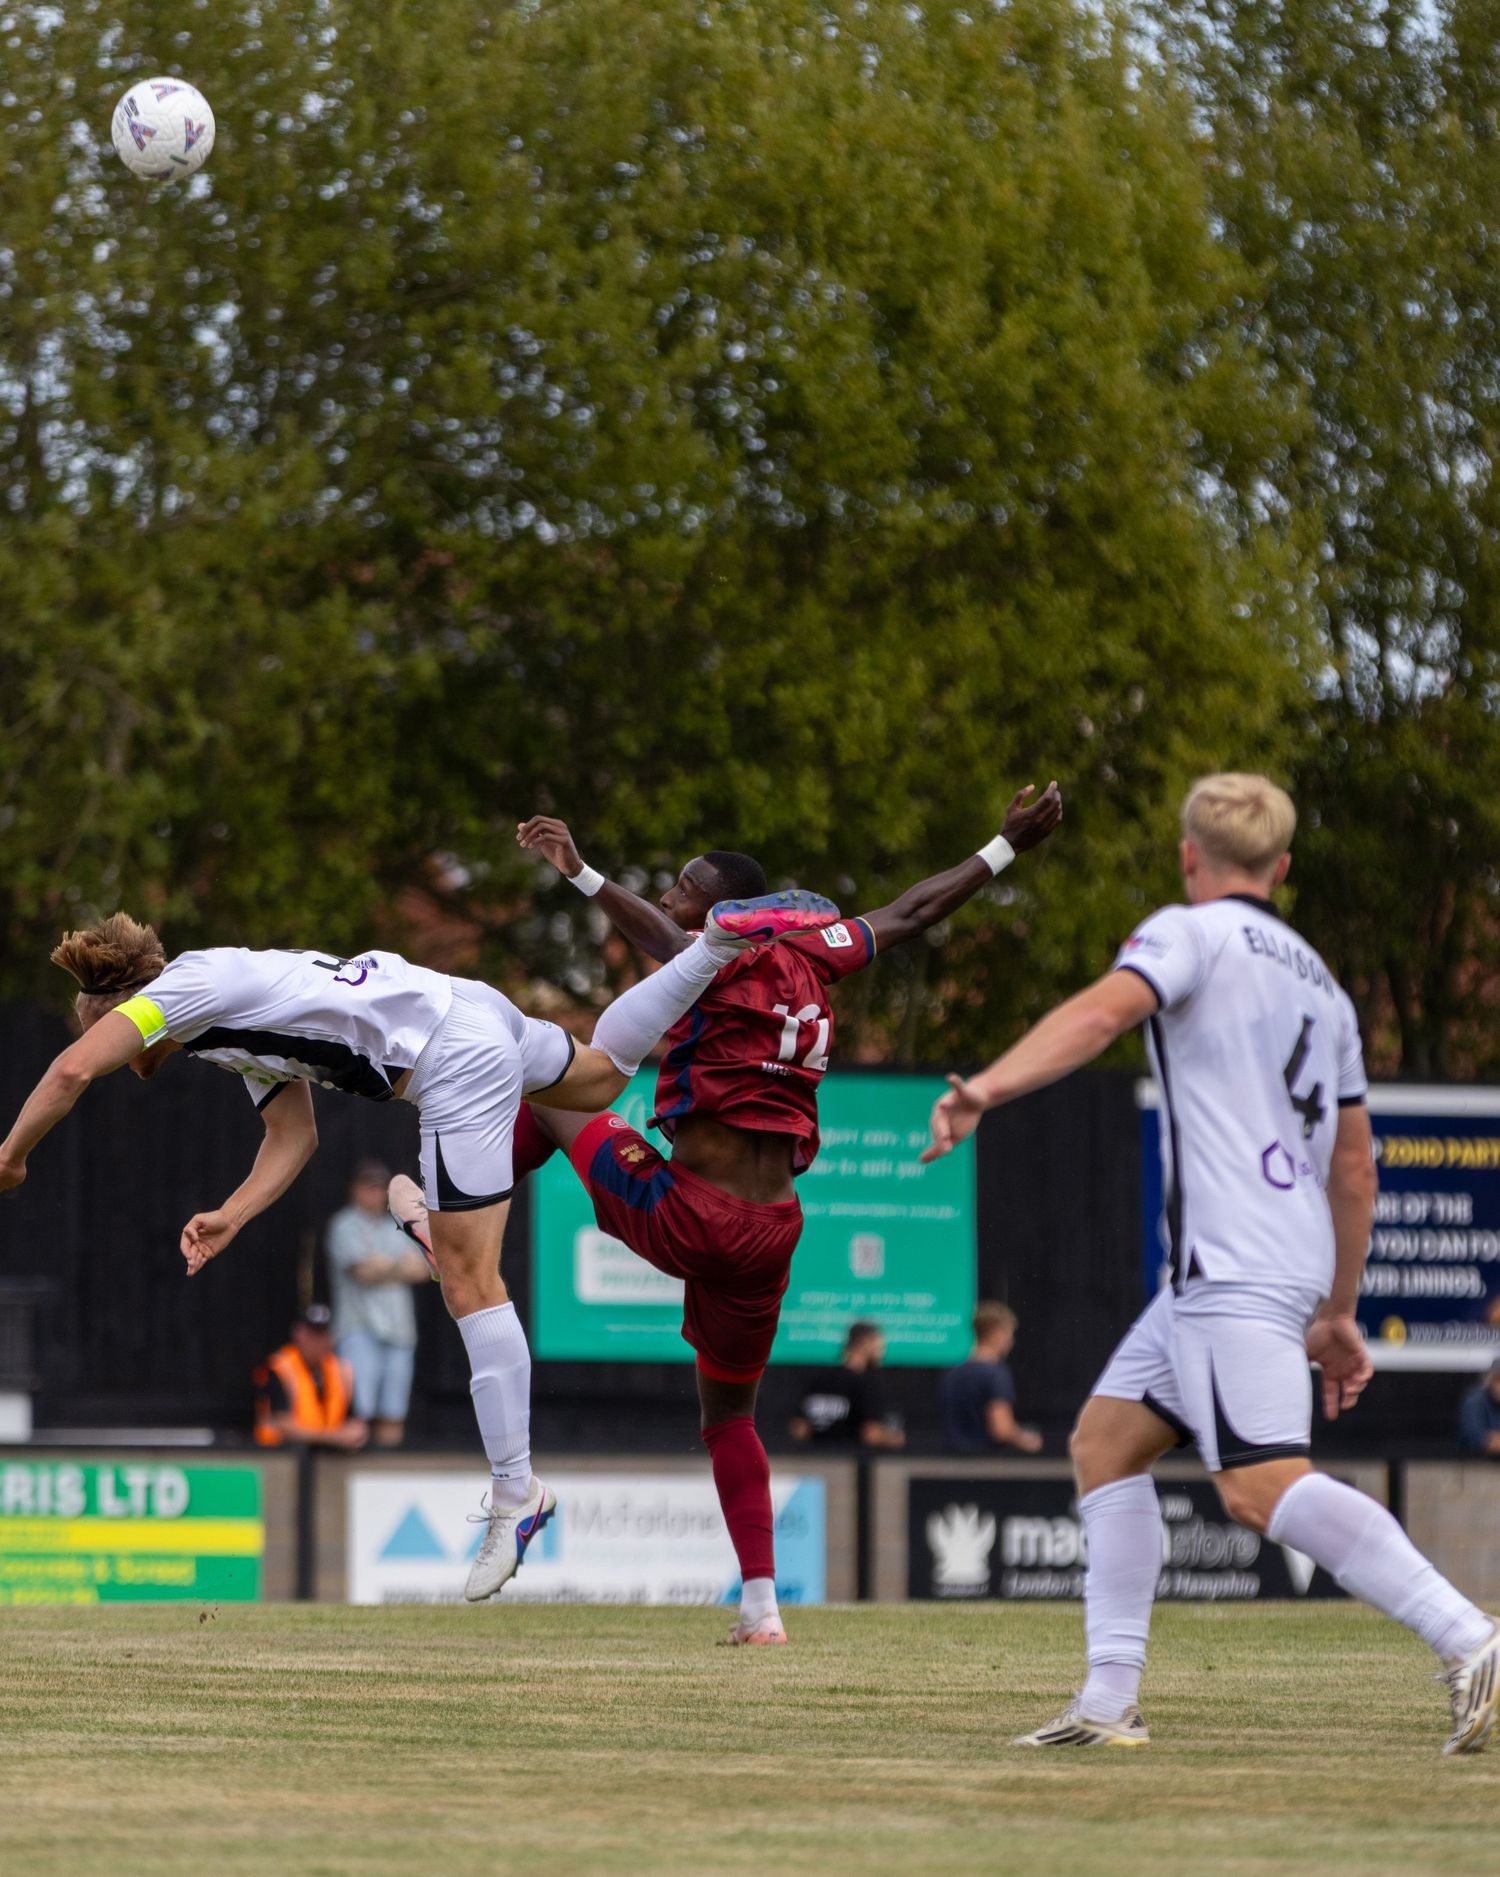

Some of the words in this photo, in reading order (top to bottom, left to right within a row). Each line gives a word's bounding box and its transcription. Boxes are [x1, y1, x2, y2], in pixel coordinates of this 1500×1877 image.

[1241, 924, 1337, 1000] ELLISON
[772, 1003, 830, 1072] 12
[1283, 1013, 1328, 1141] 4
[1382, 1136, 1445, 1167] ZOHO
[1374, 1229, 1420, 1261] YOU
[1421, 1229, 1469, 1261] CAN
[98, 1464, 190, 1518] LTD
[1002, 1571, 1072, 1598] London
[1174, 1571, 1261, 1602] Hampshire
